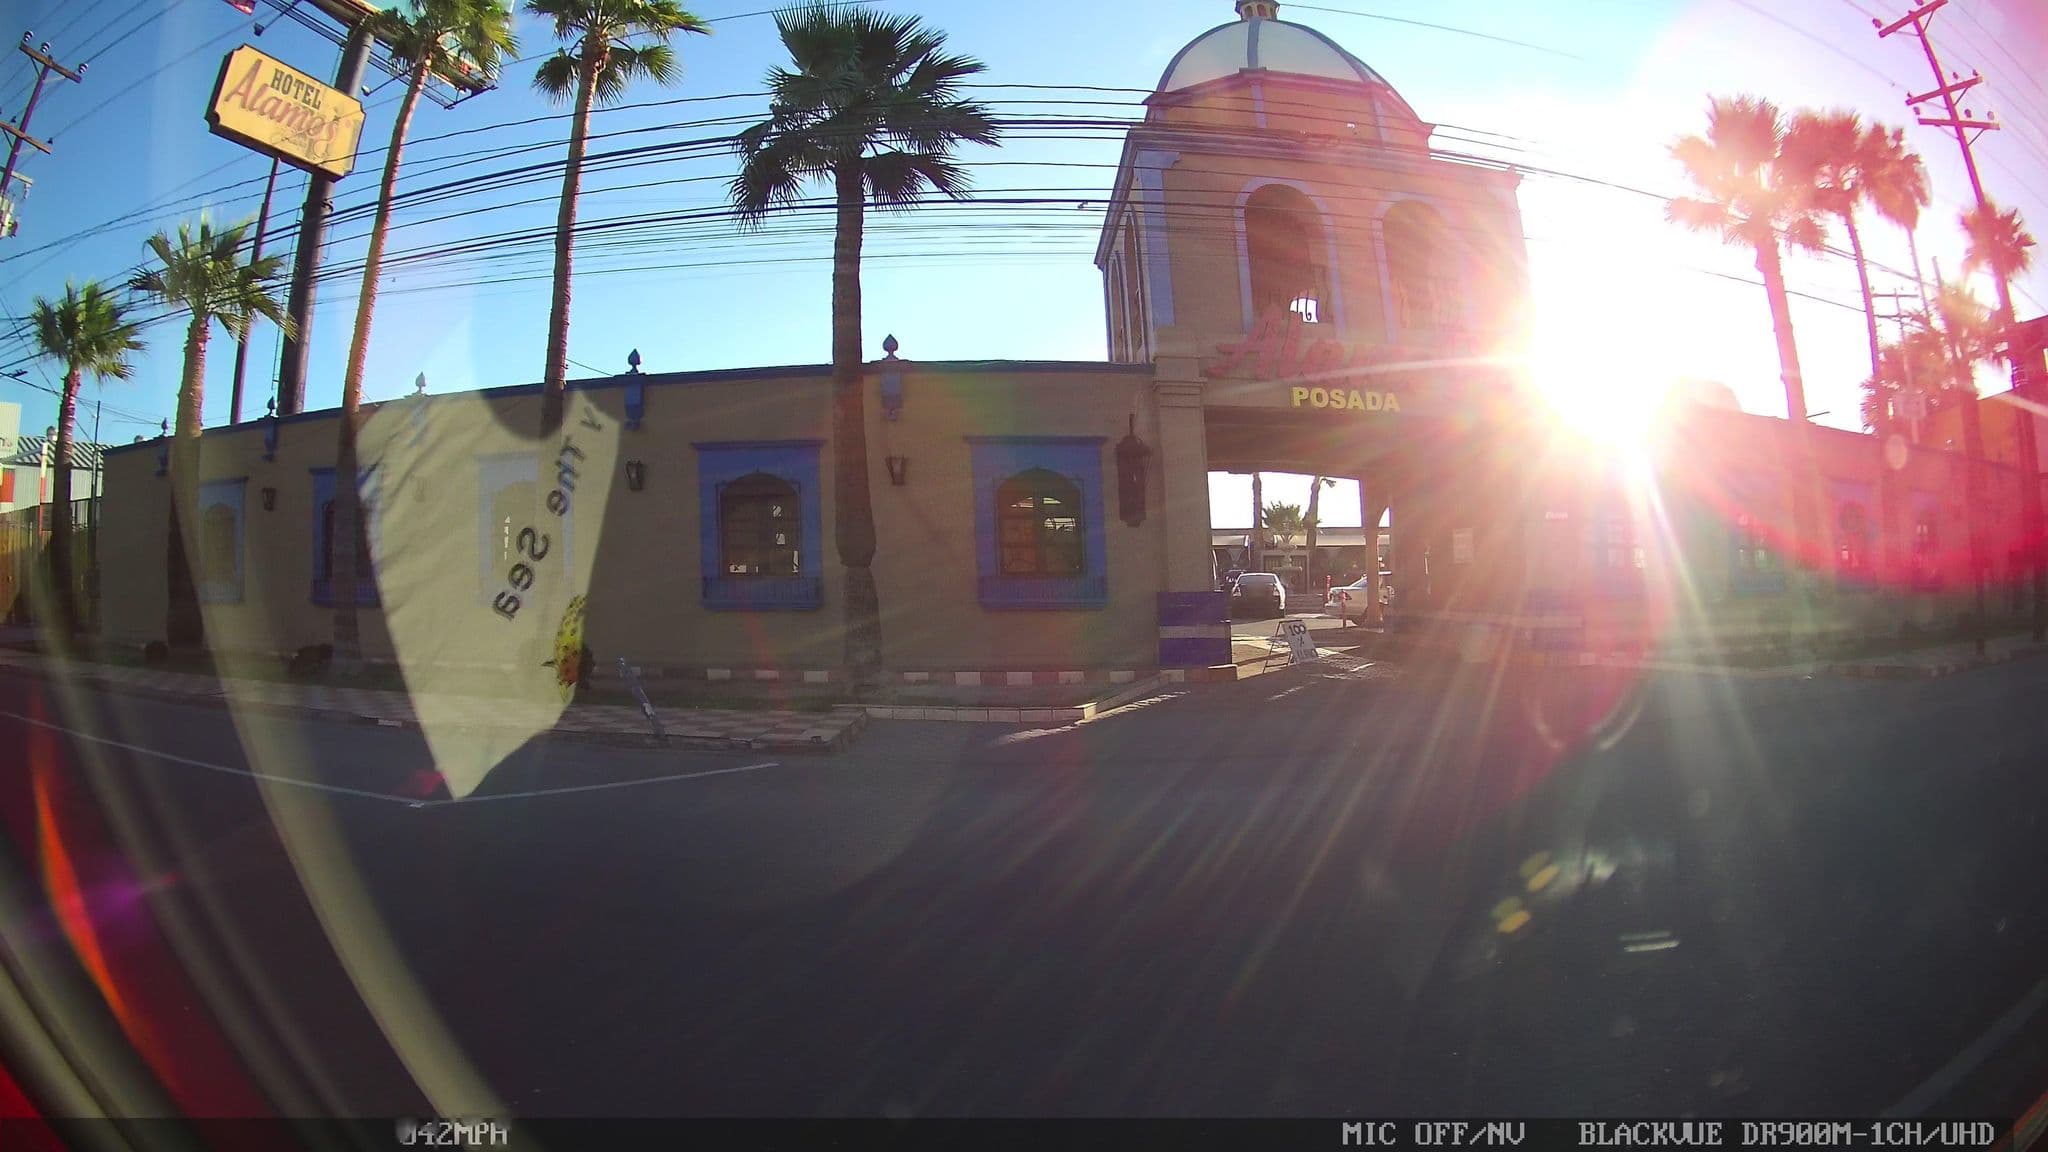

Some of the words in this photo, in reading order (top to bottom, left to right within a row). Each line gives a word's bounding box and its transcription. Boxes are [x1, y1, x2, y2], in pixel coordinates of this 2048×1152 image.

[224, 58, 338, 151] Alamos
[270, 68, 322, 110] HOTEL
[1290, 386, 1400, 412] POSADA
